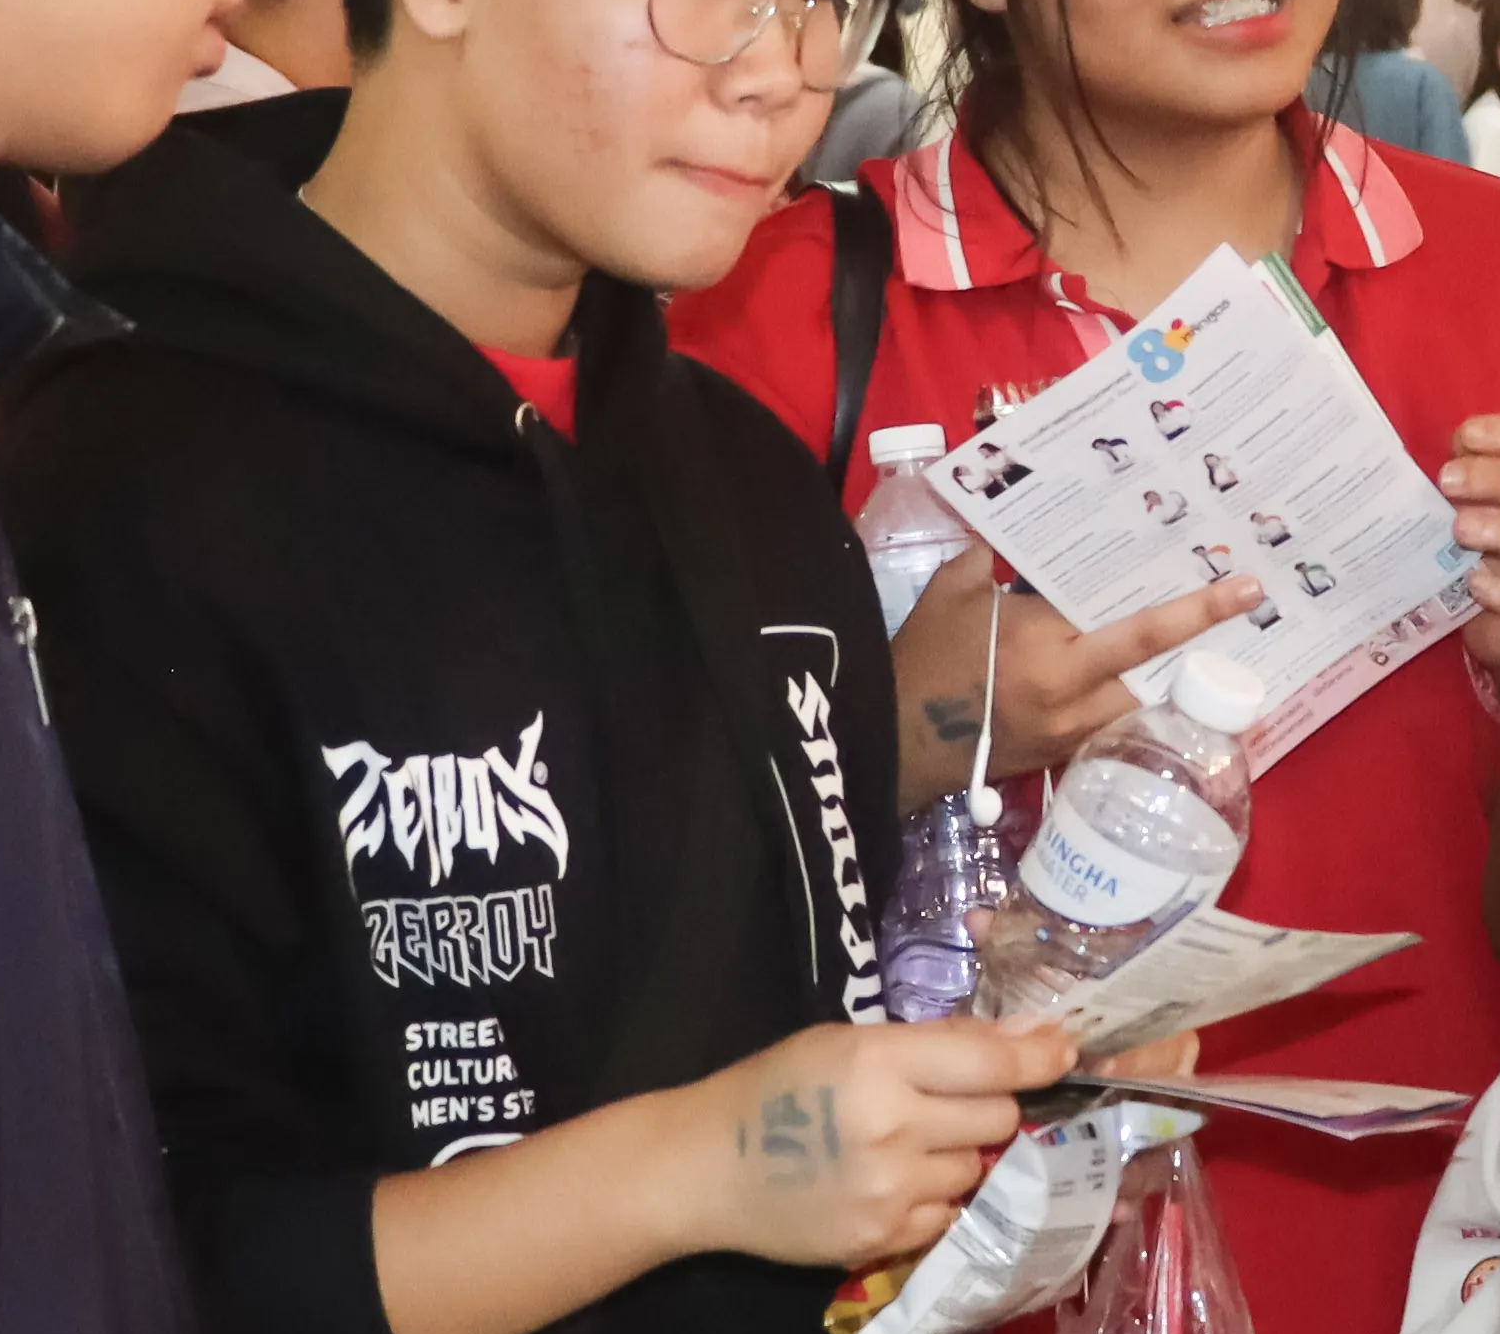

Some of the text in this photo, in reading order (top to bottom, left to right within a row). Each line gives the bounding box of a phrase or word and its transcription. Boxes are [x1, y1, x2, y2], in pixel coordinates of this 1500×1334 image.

[1038, 848, 1089, 903] ATER
[407, 1054, 518, 1091] CULTUR
[411, 1088, 536, 1129] MEN'S ST
